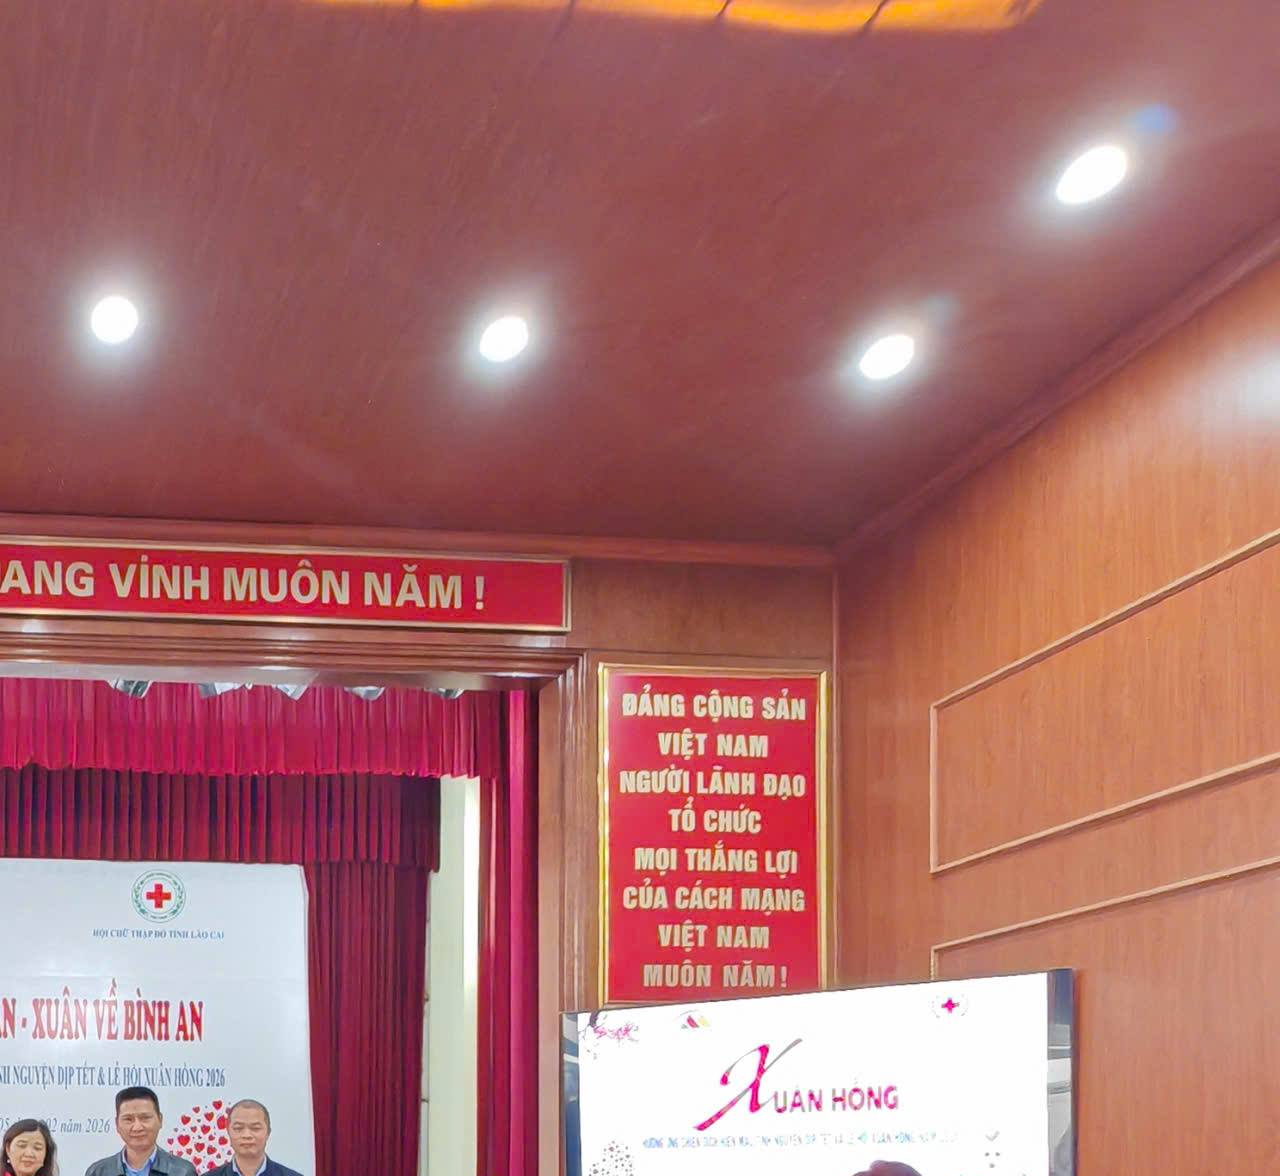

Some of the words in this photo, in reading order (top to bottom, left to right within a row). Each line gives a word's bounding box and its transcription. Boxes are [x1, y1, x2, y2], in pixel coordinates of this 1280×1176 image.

[222, 559, 350, 604] MUÔN
[363, 563, 462, 608] NĂM
[622, 684, 685, 717] ĐẢNG
[693, 690, 753, 723] CỘNG
[762, 688, 806, 721] SẢN
[658, 728, 708, 760] VIỆT
[717, 735, 768, 758] NAM
[620, 764, 690, 793] NGƯỜI
[696, 765, 755, 795] LÃNH
[763, 774, 806, 800] ĐẠO
[668, 796, 695, 832] TỔ
[704, 804, 761, 833] CHỨC
[634, 848, 677, 876] MỌI
[685, 840, 757, 872] THẮNG
[765, 850, 797, 878] LỢI
[623, 879, 667, 910] CỦA
[675, 880, 732, 910] CÁCH
[741, 887, 805, 916] MẠNG
[210, 930, 224, 940] CAI
[658, 919, 708, 952] VIỆT
[716, 926, 769, 949] NAM
[643, 959, 711, 987] MUÔN
[723, 960, 775, 988] NĂM
[32, 986, 88, 1040] XUÂN
[93, 978, 119, 1041] VỀ
[124, 988, 170, 1041] BÌNH
[175, 1001, 204, 1042] AN
[13, 1061, 58, 1089] NGUYỆN
[58, 1065, 75, 1089] DỊP
[97, 1066, 106, 1086] &
[144, 1061, 171, 1087] XUÂN
[206, 1067, 226, 1087] 2026
[85, 1118, 111, 1133] 2026
